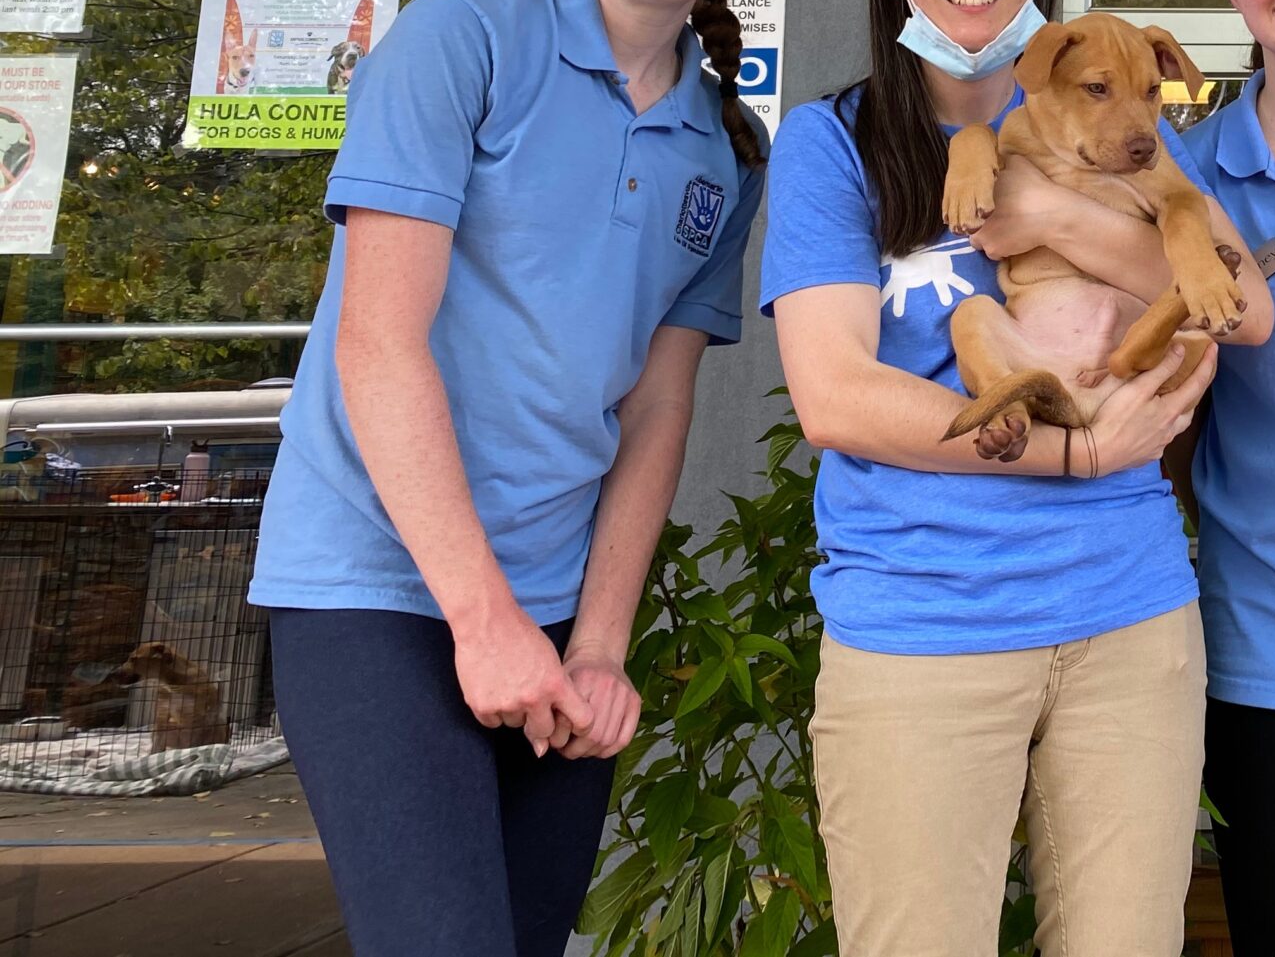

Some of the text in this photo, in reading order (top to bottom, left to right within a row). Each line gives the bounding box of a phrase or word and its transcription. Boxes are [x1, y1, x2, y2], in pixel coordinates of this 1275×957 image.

[738, 11, 756, 20] ON
[1, 67, 45, 77] MUST BE
[4, 80, 26, 90] OUR
[28, 80, 61, 90] STORE
[200, 104, 346, 121] HULA CONTE
[197, 127, 229, 139] FOR
[235, 127, 282, 140] DOGS
[286, 128, 297, 139] &
[11, 200, 54, 210] KIDDING
[682, 225, 709, 248] SPCA
